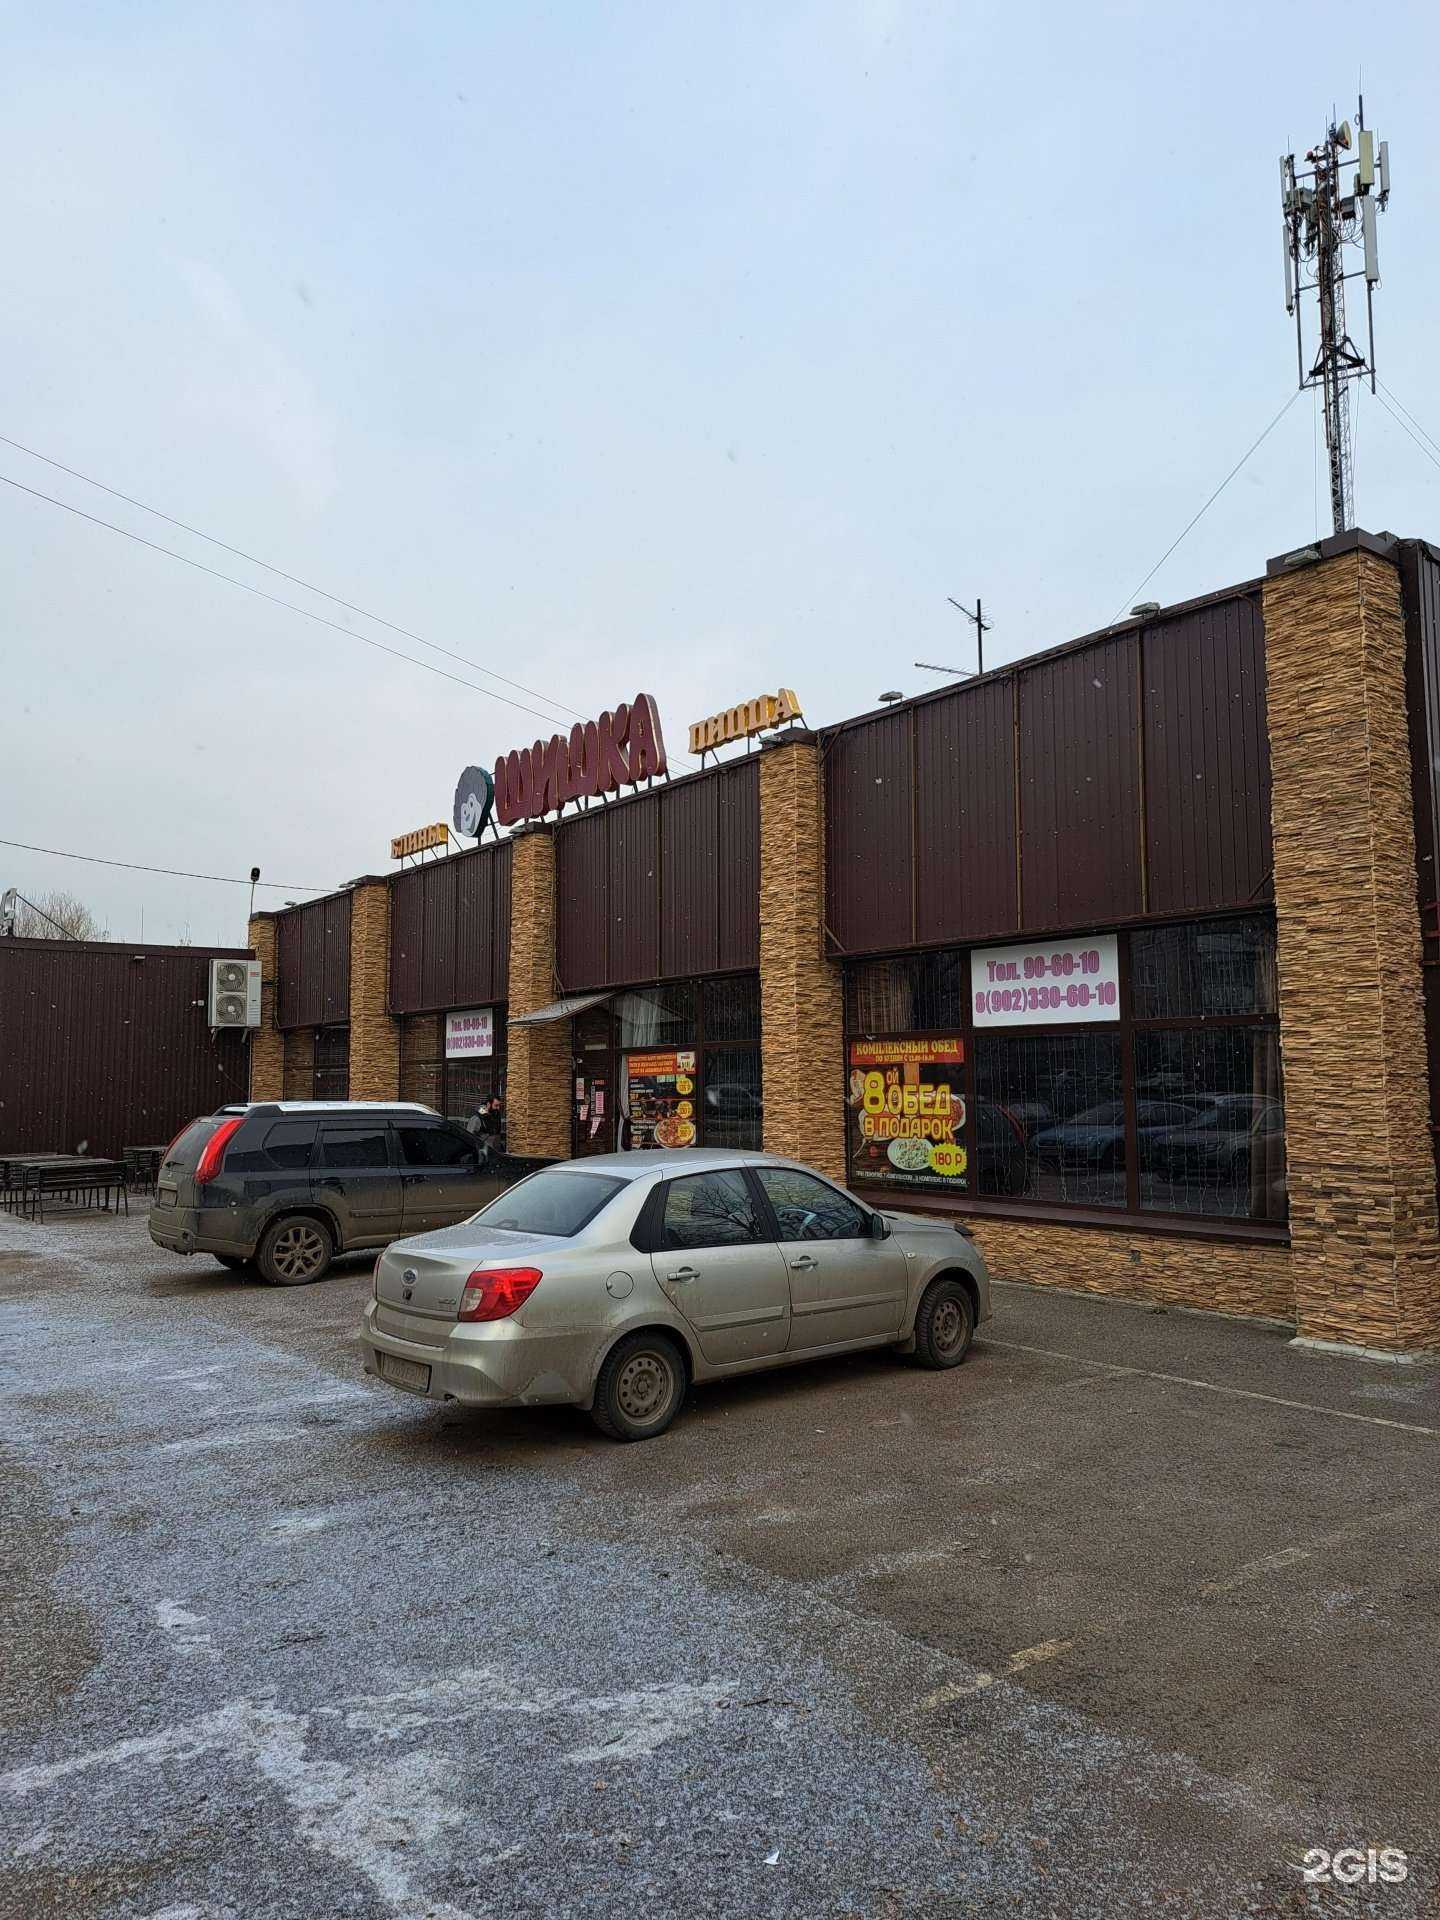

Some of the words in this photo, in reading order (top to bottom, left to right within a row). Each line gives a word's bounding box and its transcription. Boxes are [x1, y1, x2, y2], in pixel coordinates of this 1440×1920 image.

[688, 687, 803, 754] ПИЦЦА
[494, 692, 667, 826] ШИШКА
[391, 823, 448, 859] БЛИНЫ
[987, 960, 1021, 982] Тел.
[1024, 950, 1100, 979] 90-60-10
[975, 981, 1117, 1015] 8(902)330-60-10
[856, 1040, 929, 1055] КОМПЛЕКСНЫЙ
[931, 1038, 959, 1053] ОБЕД
[887, 1083, 952, 1115] ОБЕД
[864, 1117, 874, 1137] В
[878, 1117, 954, 1140] ПОДАРОК
[934, 1152, 952, 1167] 180
